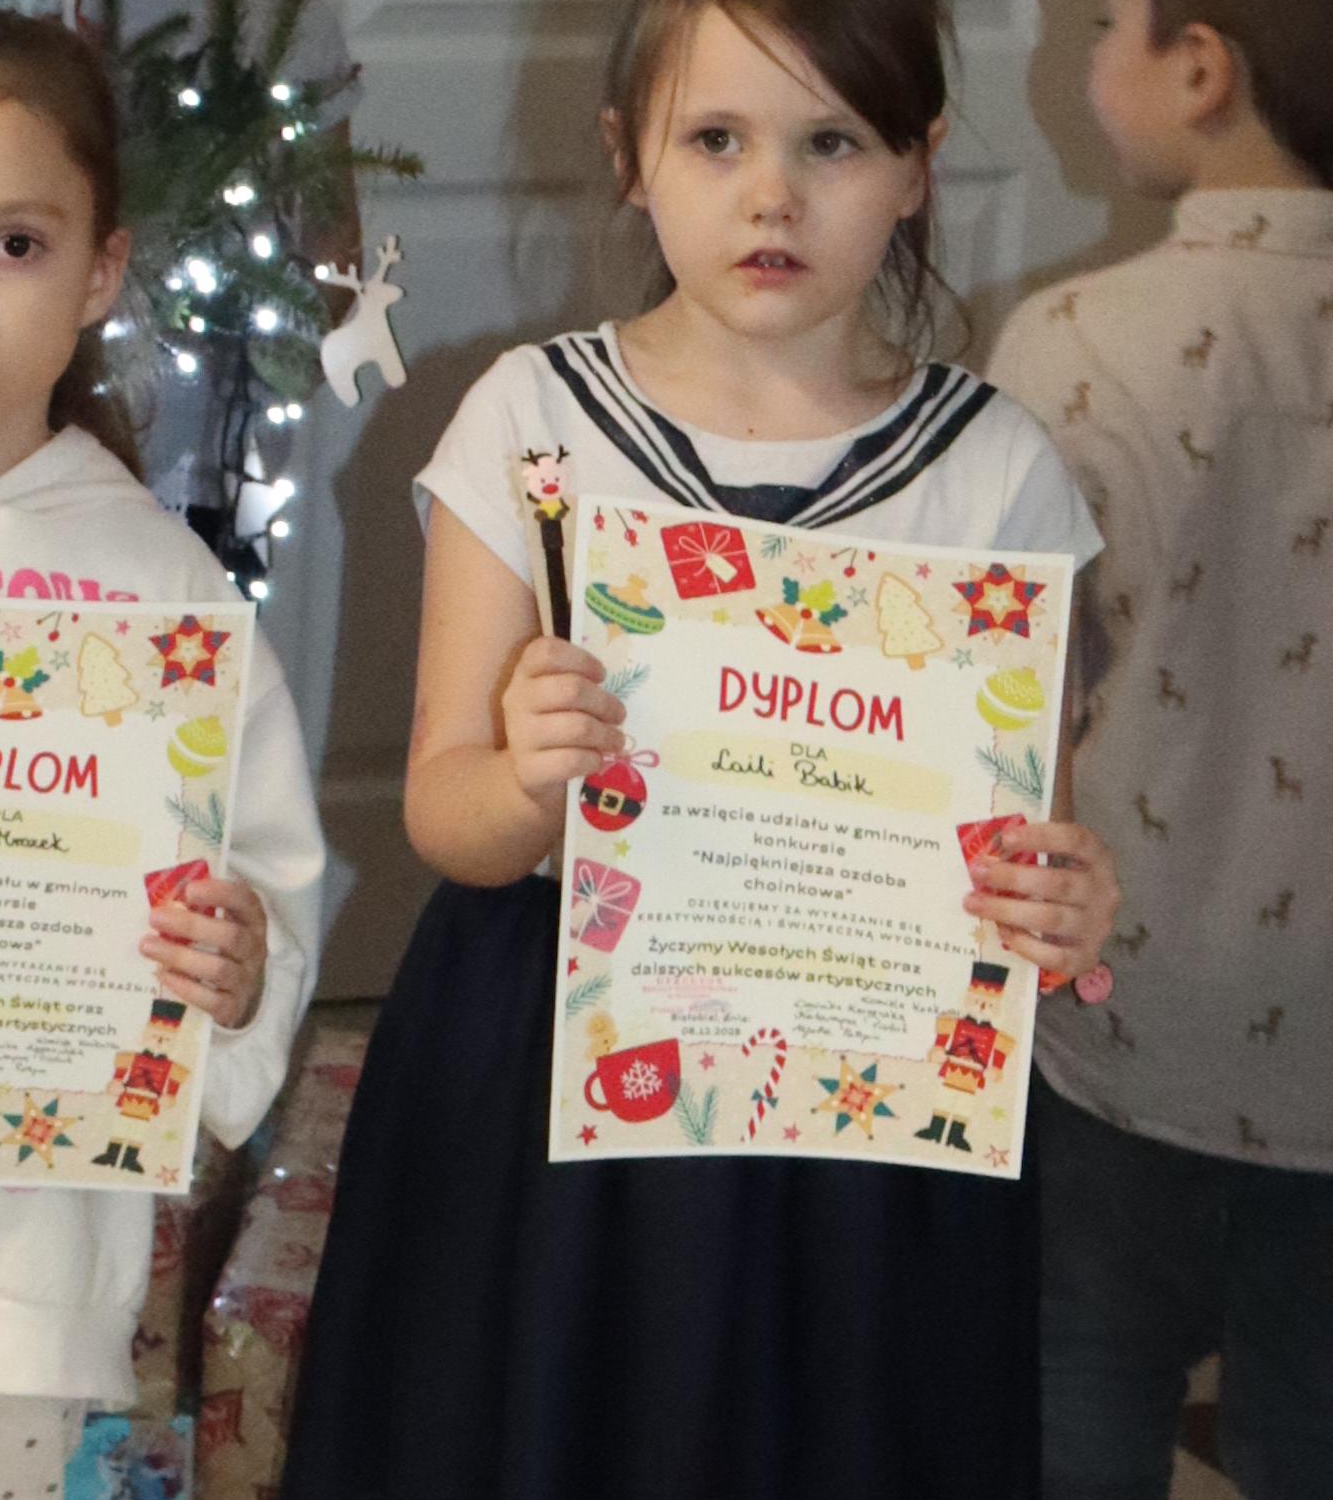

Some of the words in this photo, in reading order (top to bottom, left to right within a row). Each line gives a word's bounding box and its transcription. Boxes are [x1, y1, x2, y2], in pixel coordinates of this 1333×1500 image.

[719, 667, 904, 740] DYPLOM
[790, 743, 827, 761] DLA
[662, 805, 682, 816] za
[688, 805, 756, 822] wzięcie
[761, 813, 829, 832] udziału
[834, 824, 848, 834] w
[853, 827, 940, 851] gminnym
[754, 832, 846, 856] konkursie
[27, 881, 41, 890] w
[44, 882, 127, 900] gminnym
[840, 869, 907, 889] ozdoba
[30, 921, 94, 936] ozdoba
[649, 936, 724, 956] Życzymy
[728, 941, 817, 960] Wesołych
[823, 947, 876, 969] Świąt
[881, 960, 921, 975] oraz
[632, 962, 707, 978] dalszych
[711, 964, 803, 982] sukcesów
[808, 973, 938, 998] artystycznych
[11, 994, 61, 1014] Świąt
[66, 1003, 104, 1016] oraz
